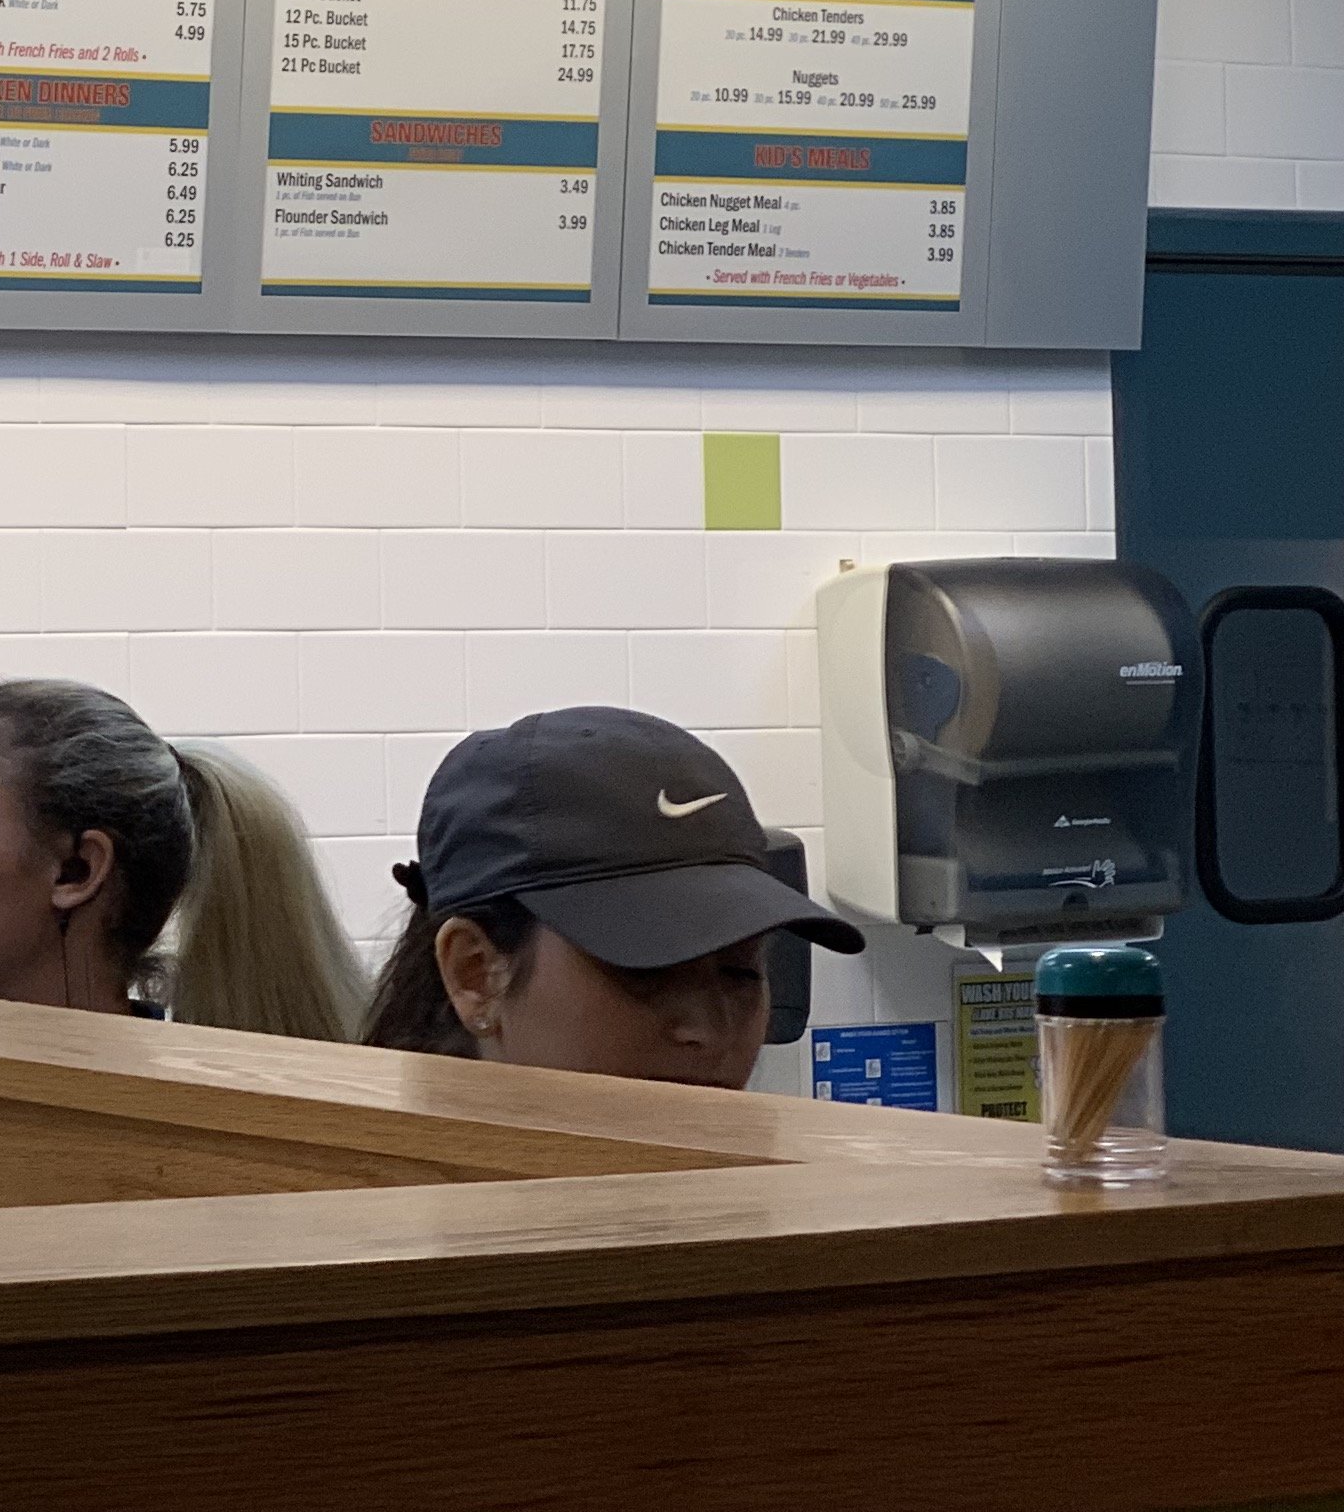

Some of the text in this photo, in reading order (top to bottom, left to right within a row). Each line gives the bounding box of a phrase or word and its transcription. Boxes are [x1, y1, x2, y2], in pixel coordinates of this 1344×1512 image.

[772, 6, 864, 25] Chicken Tenders
[174, 24, 205, 40] 4.99
[792, 69, 839, 88] Nuggets
[38, 80, 128, 105] DINNERS
[372, 120, 500, 145] SANDWICHES
[755, 145, 868, 170] KID'S MEALS
[276, 172, 588, 194] Whiting Sandwich 3.49
[659, 215, 955, 238] Chicken Leg Meal 3.85
[164, 231, 194, 247] 6.25
